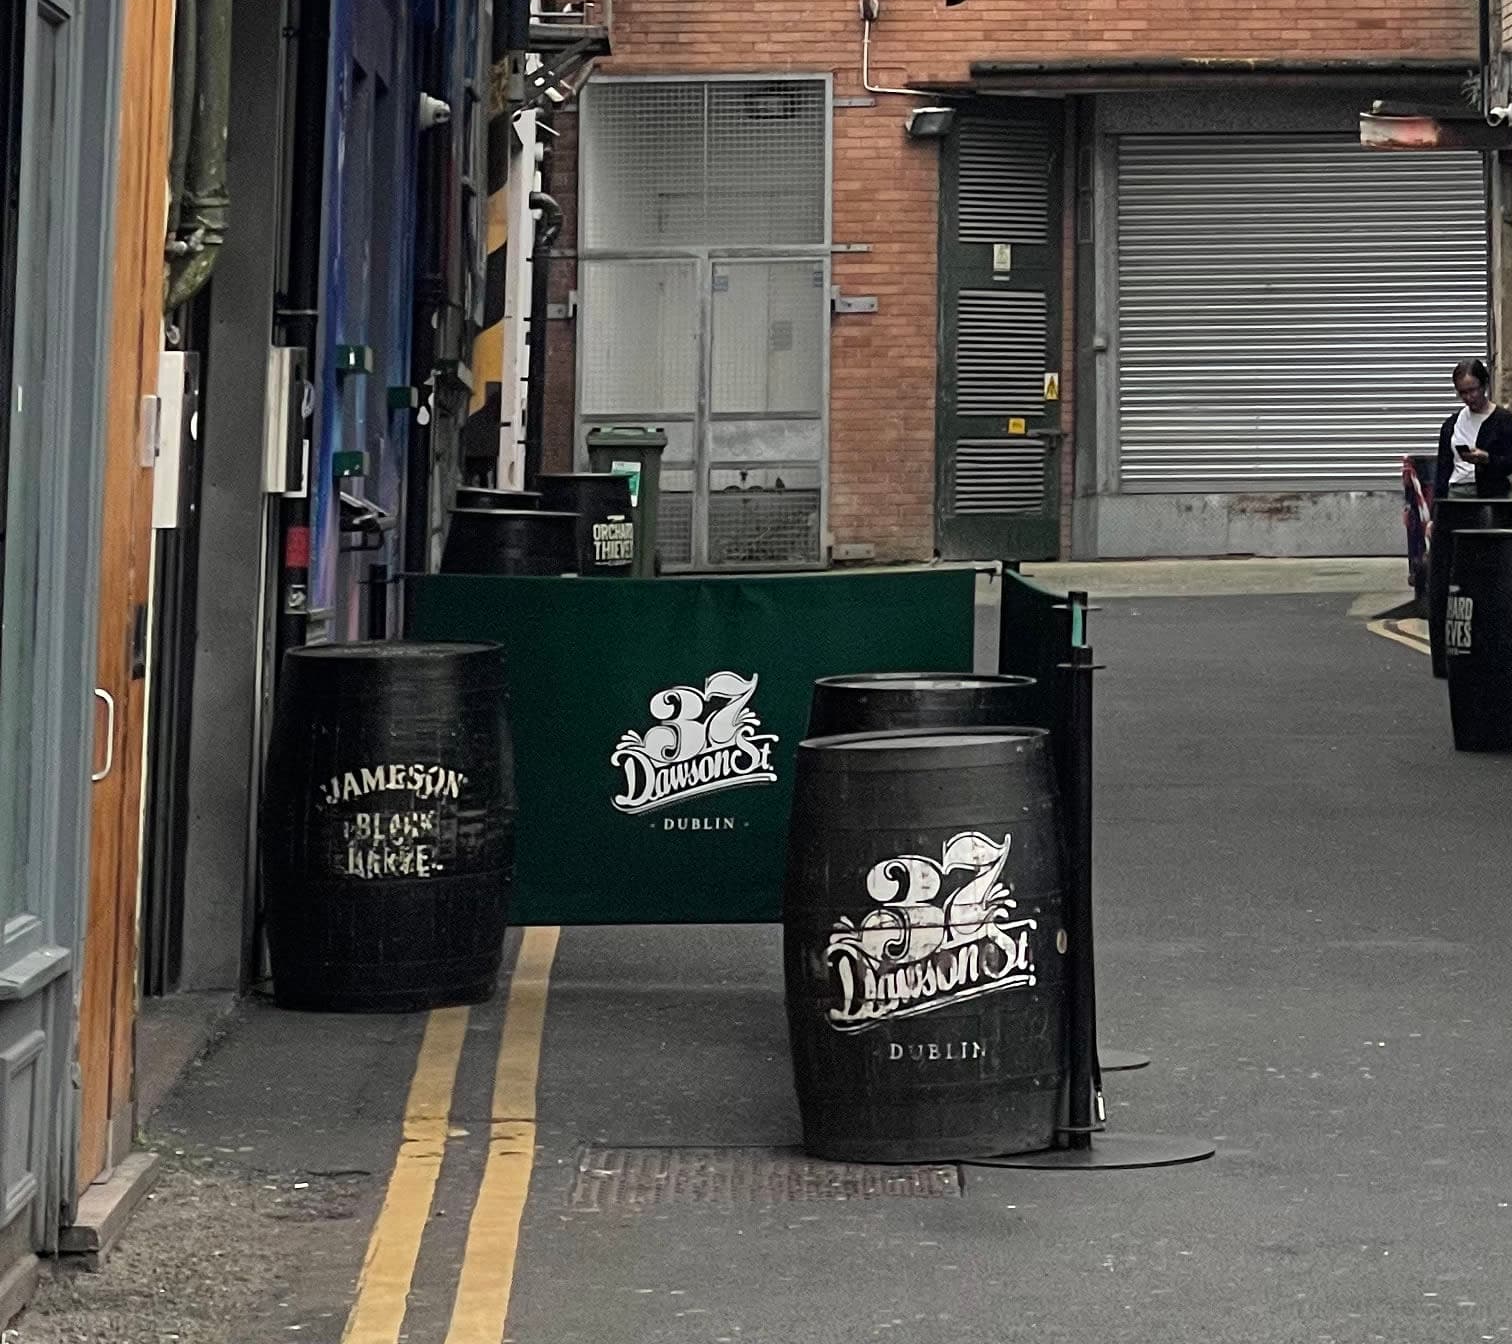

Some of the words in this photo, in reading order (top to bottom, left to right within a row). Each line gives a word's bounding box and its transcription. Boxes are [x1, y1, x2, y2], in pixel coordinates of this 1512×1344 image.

[643, 670, 759, 764] 37
[324, 764, 466, 805] JAMESON
[611, 749, 732, 807] Dawson
[731, 726, 780, 775] St.
[664, 817, 735, 830] DUBLIN
[859, 831, 1012, 964] 37
[824, 942, 980, 1022] Dawson
[889, 1041, 987, 1061] DUBLIN
